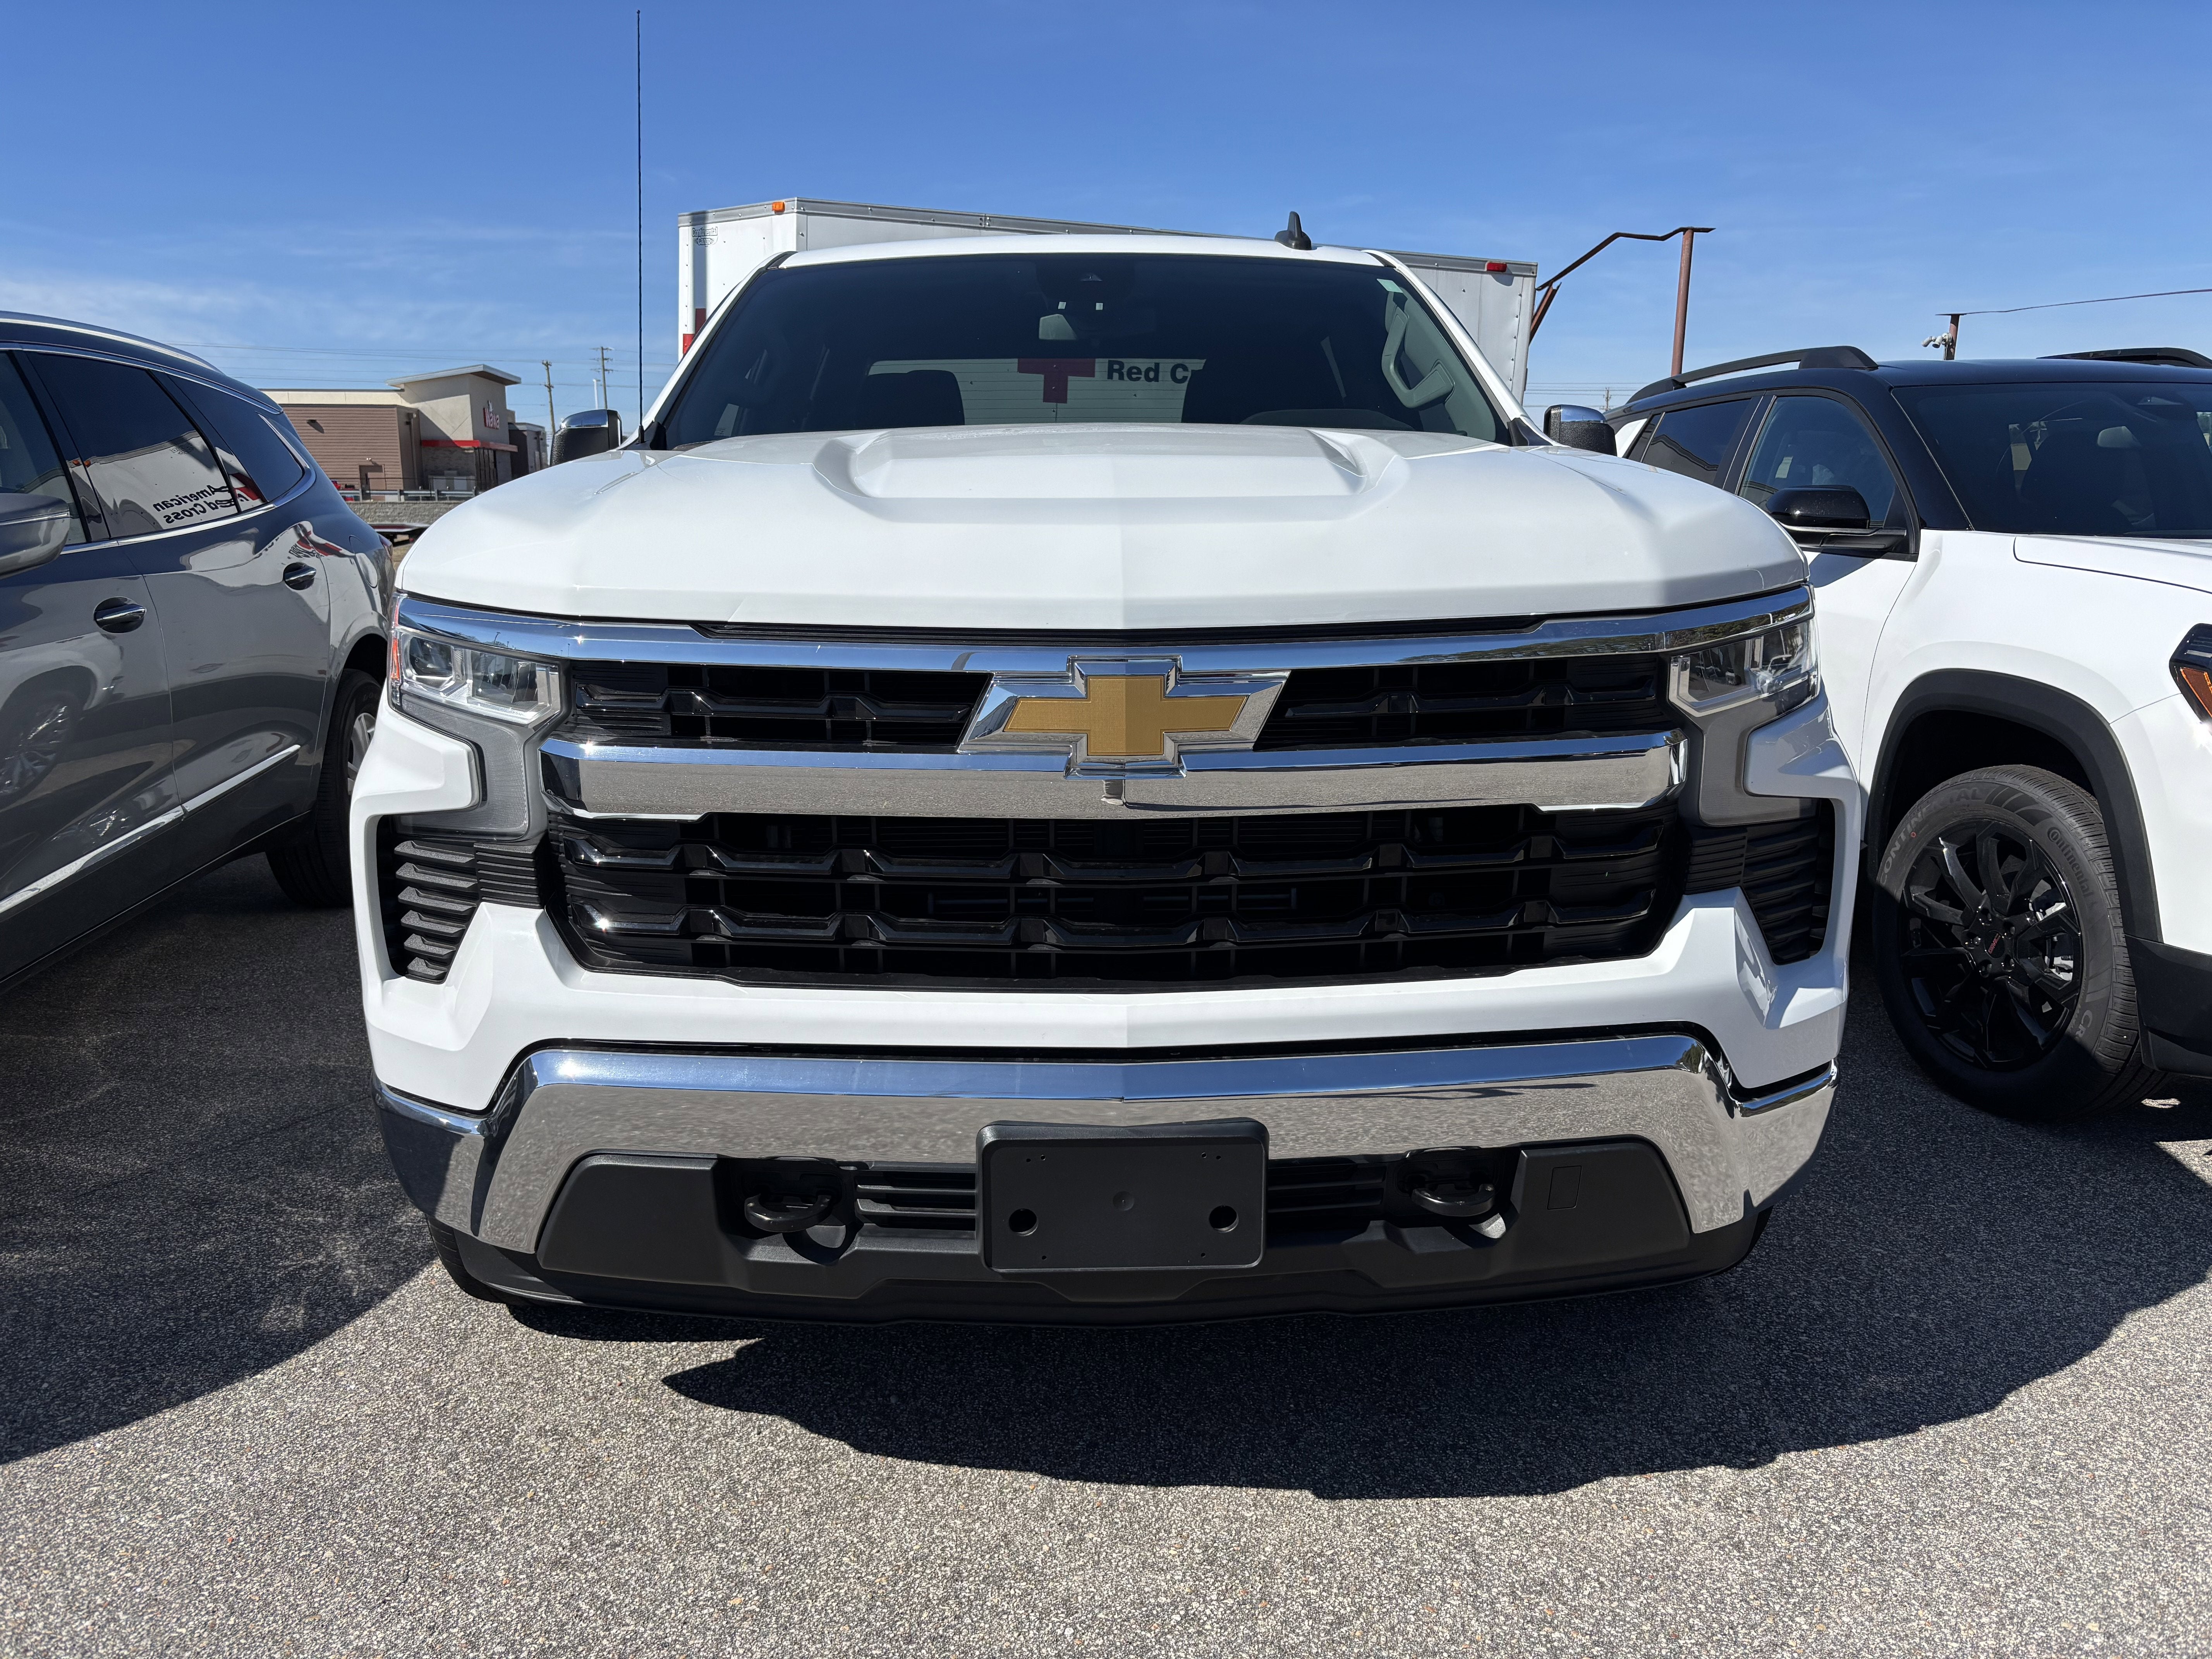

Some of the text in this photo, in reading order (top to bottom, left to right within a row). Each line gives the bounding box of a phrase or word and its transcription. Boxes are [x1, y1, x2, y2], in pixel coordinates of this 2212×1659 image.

[692, 227, 718, 237] Continental
[697, 237, 712, 247] Cargo
[1107, 359, 1160, 383] Red
[484, 407, 499, 429] Wawa
[1880, 788, 1982, 886] CONTINEAL
[2047, 826, 2094, 897] Continental
